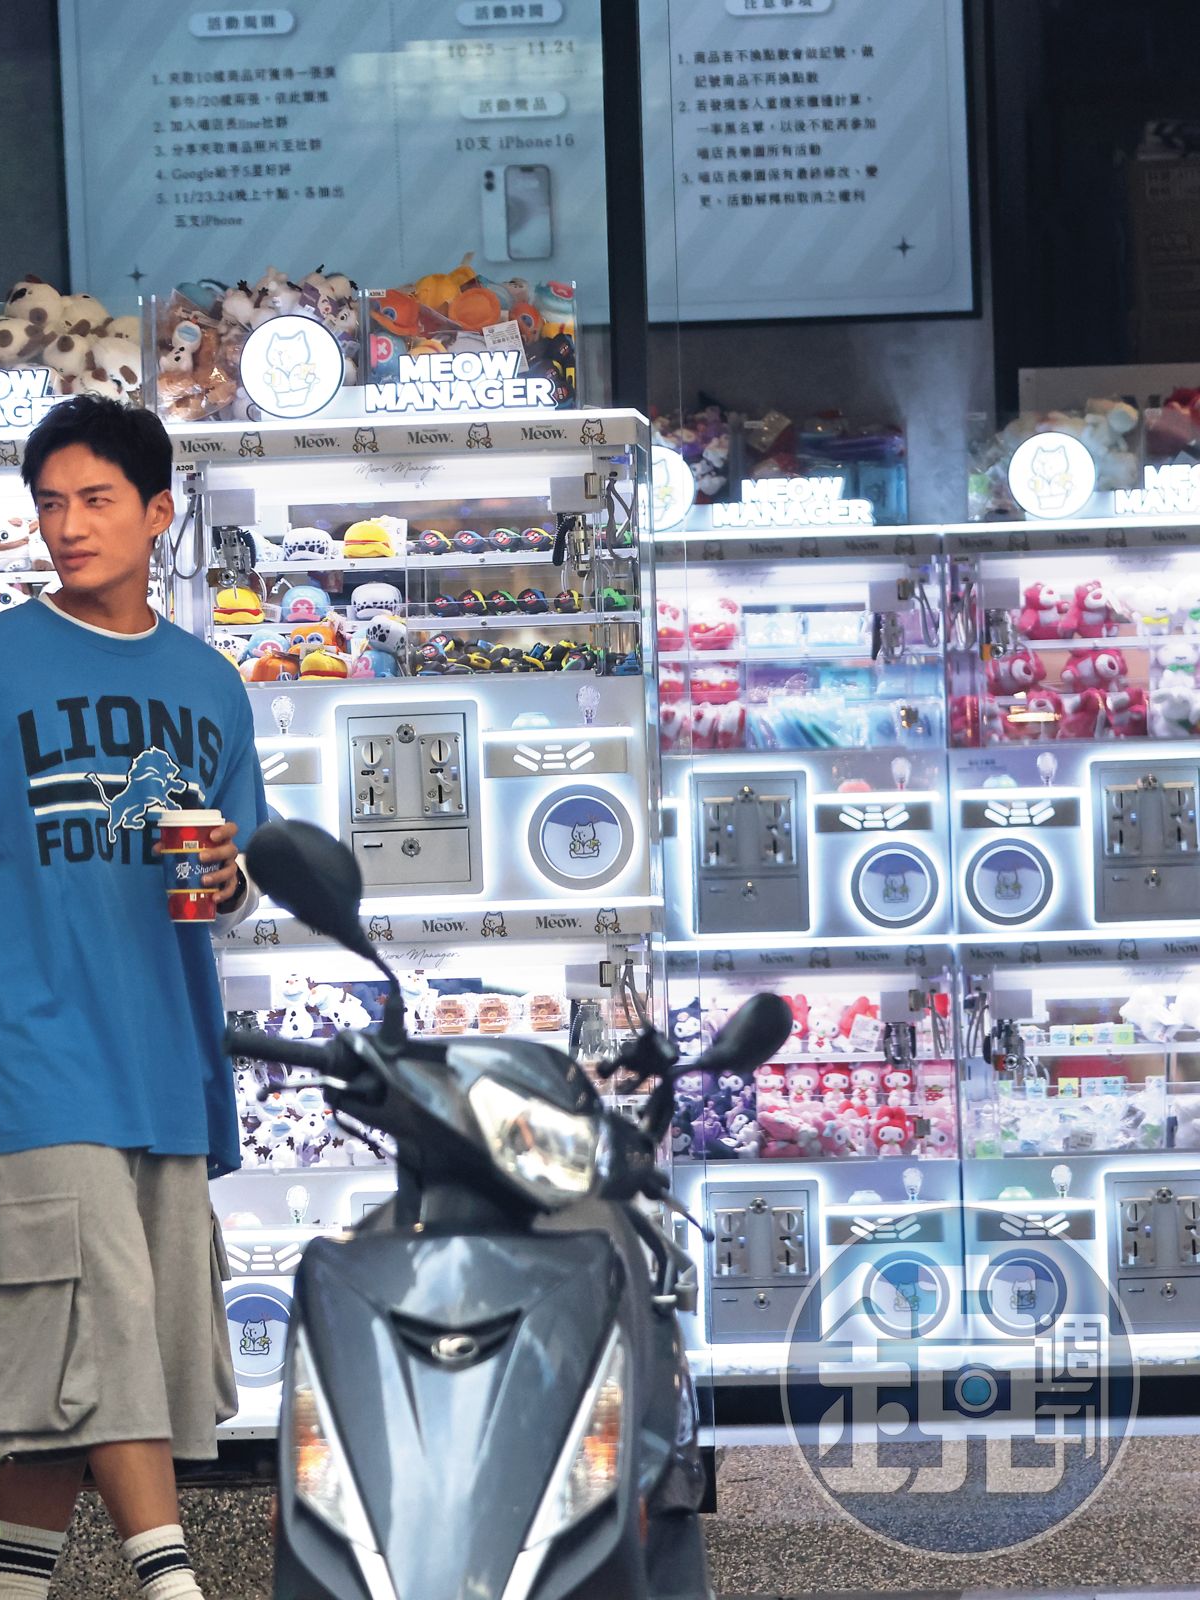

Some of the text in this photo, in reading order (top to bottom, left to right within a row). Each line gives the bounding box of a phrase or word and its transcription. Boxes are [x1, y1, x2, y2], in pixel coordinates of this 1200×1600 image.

[399, 350, 520, 381] MEOW
[365, 378, 557, 412] MANAGER
[740, 477, 845, 502] MEOW
[712, 499, 875, 527] MANAGER
[17, 695, 223, 789] LIONS
[422, 919, 469, 934] Meow.
[535, 915, 582, 930] Meow.
